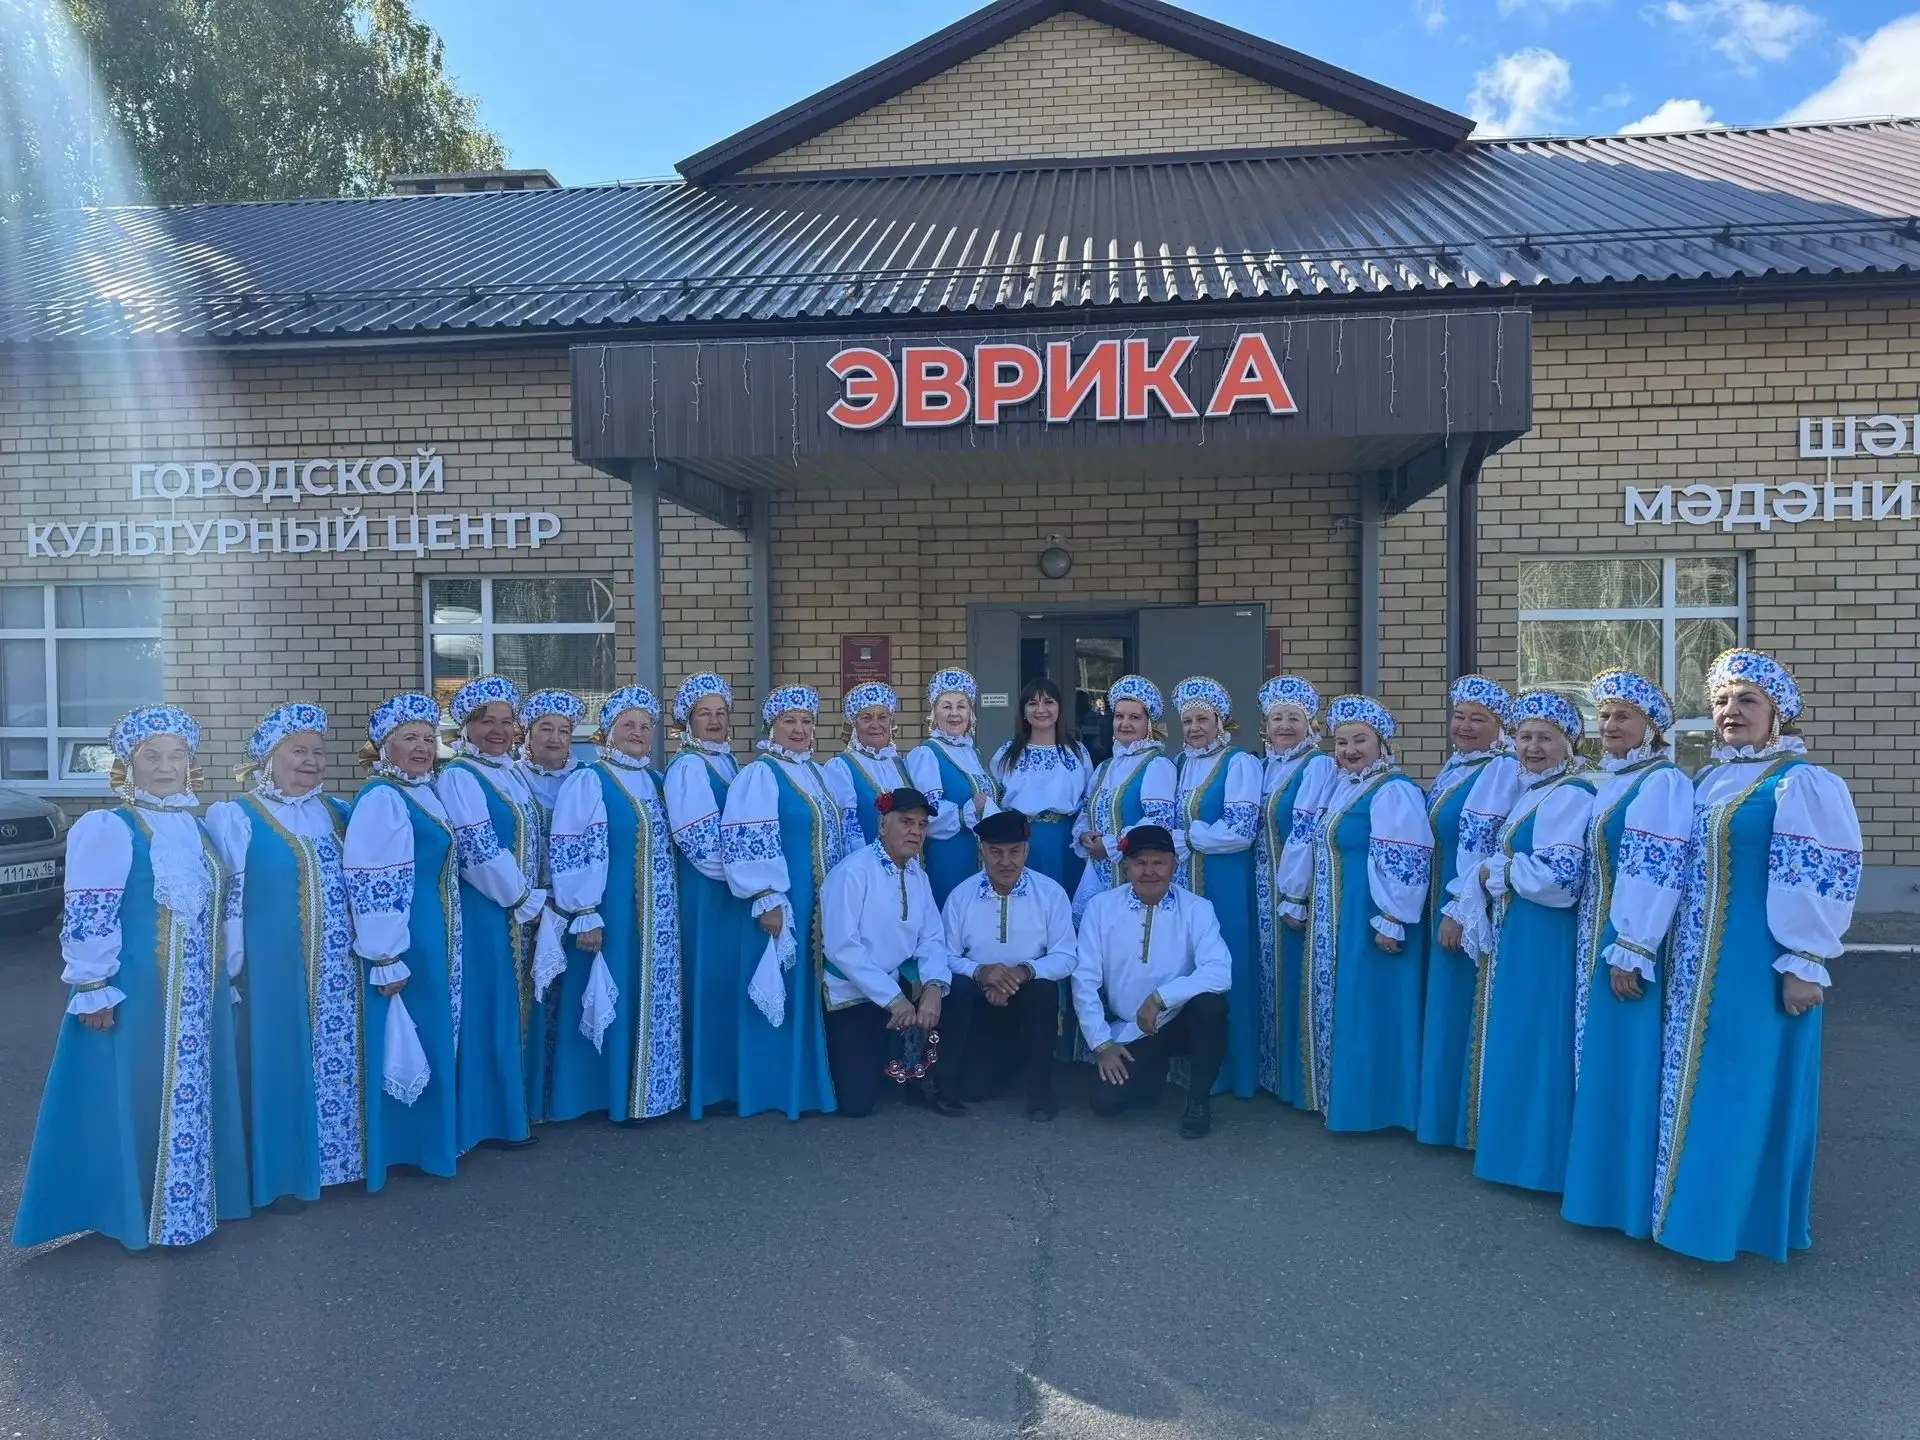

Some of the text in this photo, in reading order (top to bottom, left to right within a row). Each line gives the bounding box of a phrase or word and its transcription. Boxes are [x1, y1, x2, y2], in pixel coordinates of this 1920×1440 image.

[826, 333, 1298, 429] ЭВРИКА
[1800, 414, 1920, 458] ШӘ
[132, 447, 444, 503] ГОРОДСКОЙ
[1625, 480, 1920, 531] МӘДӘНИ
[27, 506, 562, 558] КУЛЬТУРНЫЙ ЦЕНТР
